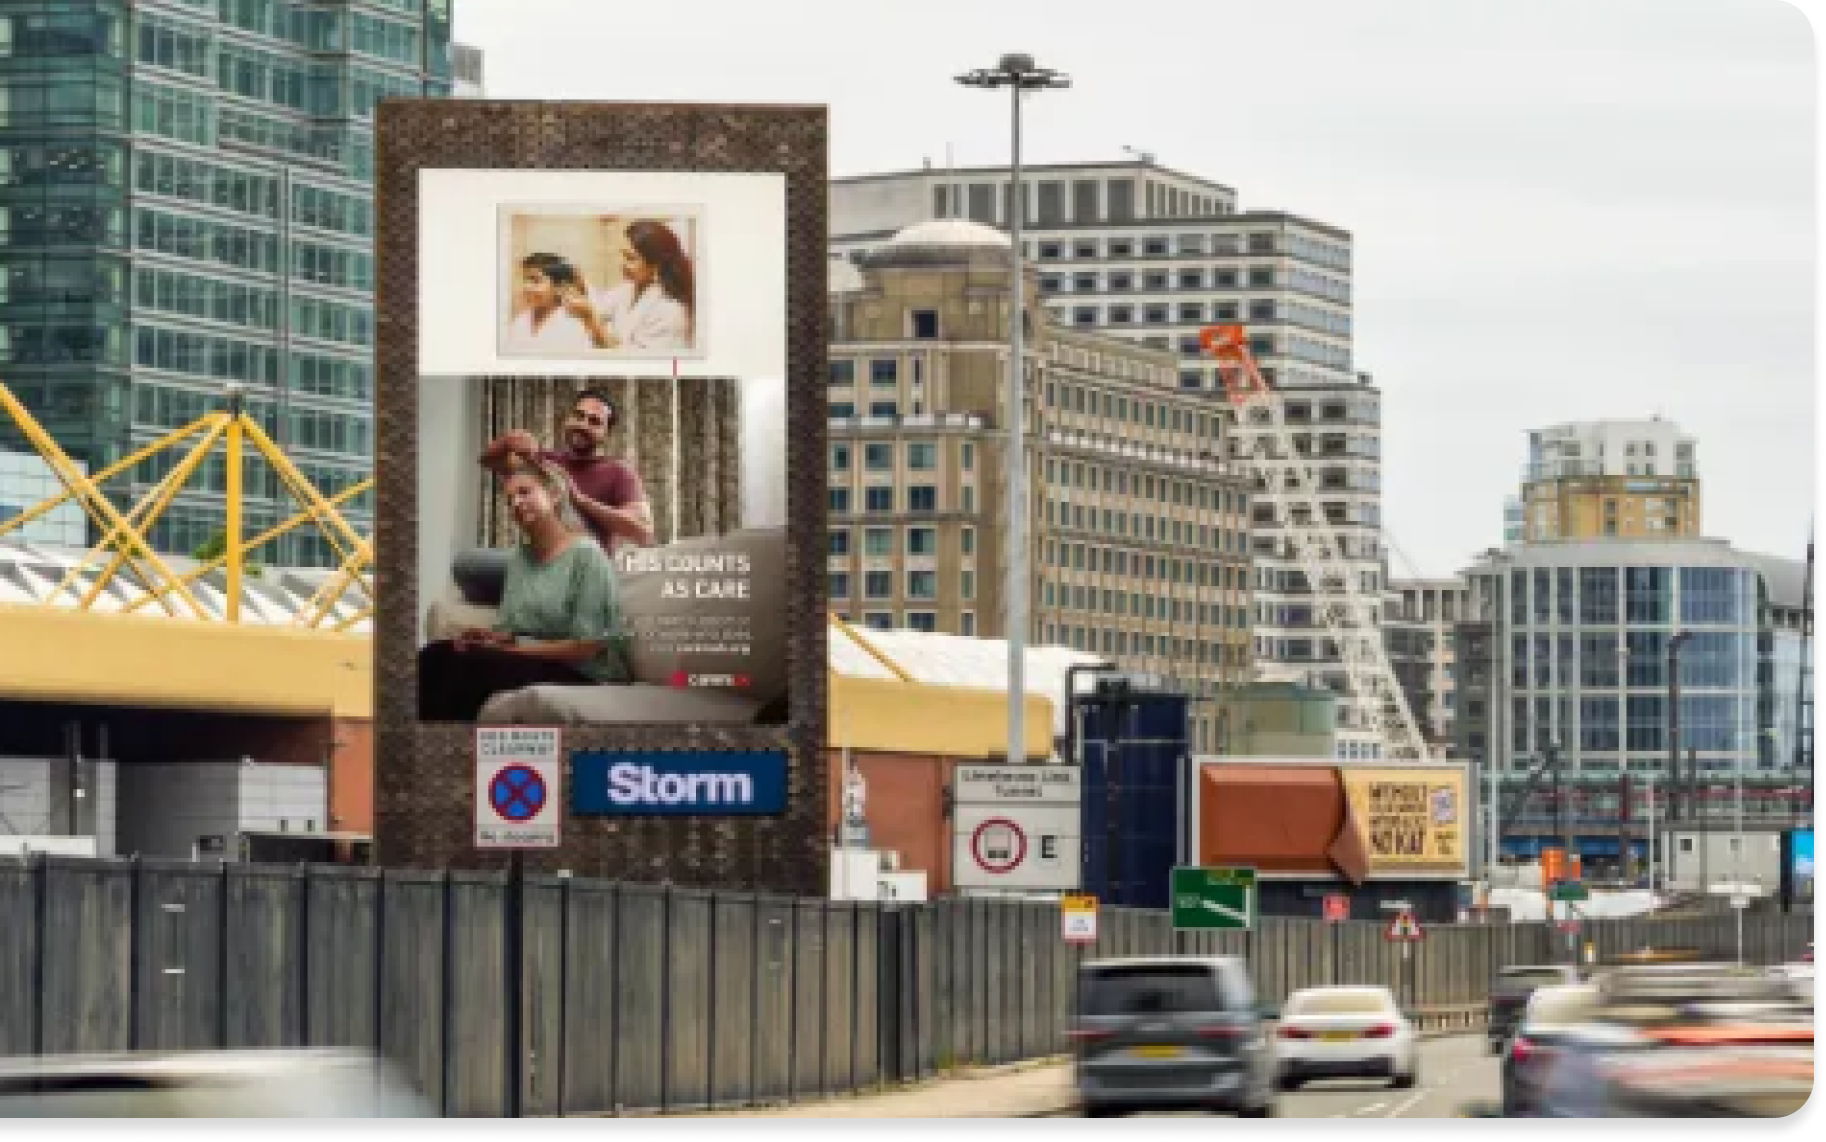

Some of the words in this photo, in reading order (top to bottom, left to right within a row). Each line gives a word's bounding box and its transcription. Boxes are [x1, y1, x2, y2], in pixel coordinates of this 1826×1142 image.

[664, 551, 751, 573] COUNTS
[660, 577, 689, 599] AS
[694, 577, 751, 599] CARE
[606, 761, 754, 805] Storm
[1038, 835, 1059, 859] E
